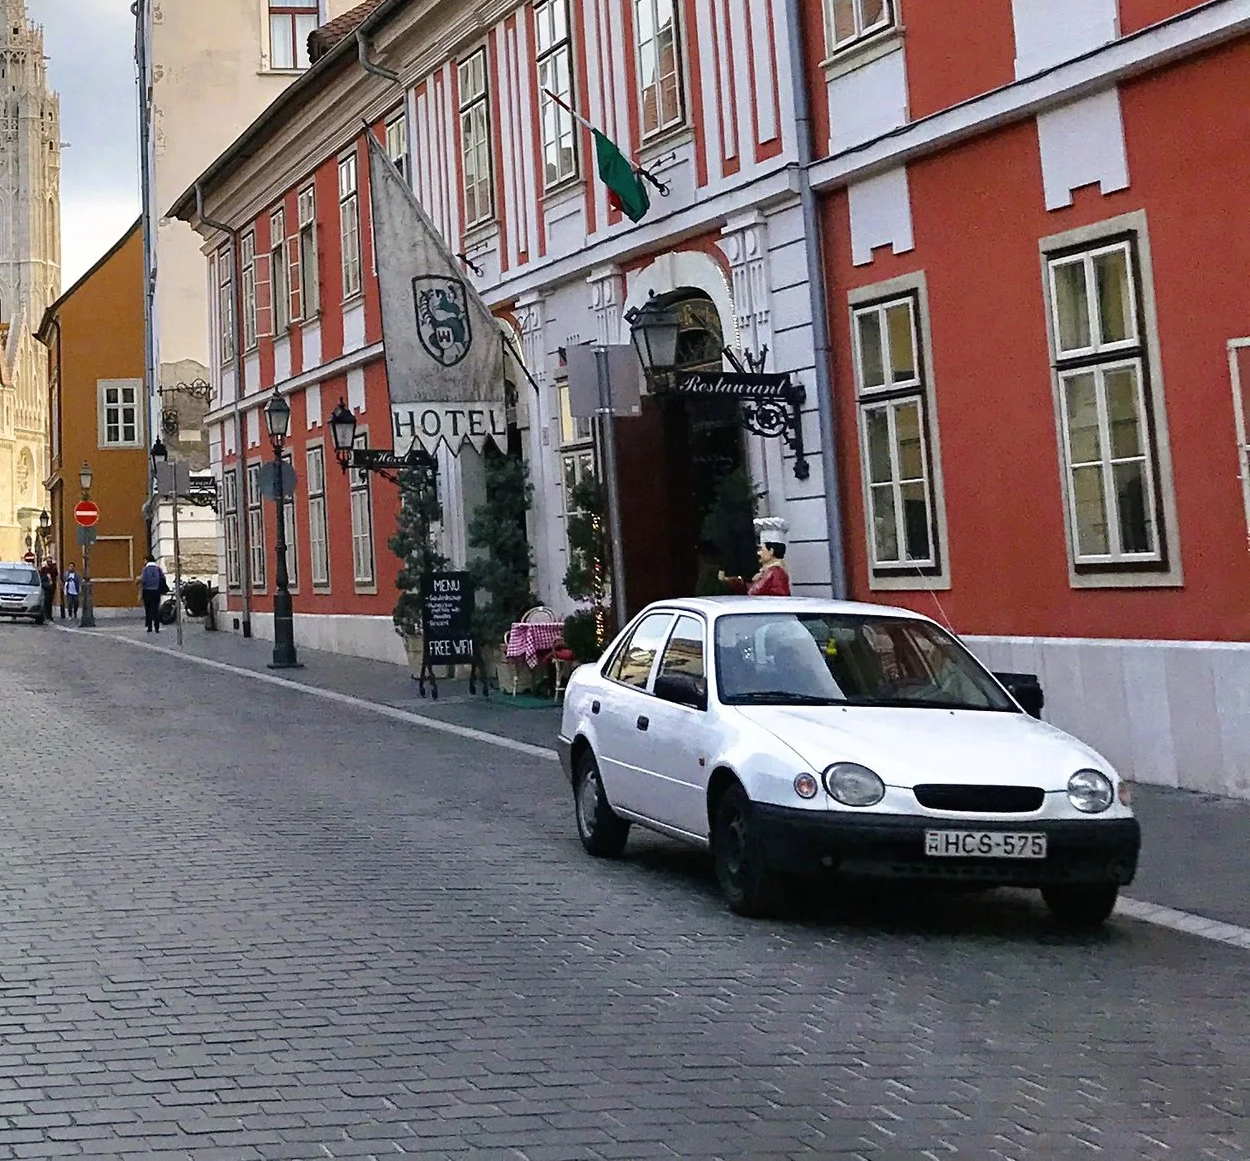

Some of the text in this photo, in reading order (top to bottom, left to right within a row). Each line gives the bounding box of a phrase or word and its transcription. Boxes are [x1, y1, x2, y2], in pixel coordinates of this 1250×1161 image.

[679, 375, 786, 394] Restaurant
[393, 409, 507, 437] HOTEL
[433, 579, 460, 592] MENU
[429, 640, 451, 656] FREE
[945, 833, 1044, 855] HCS-575
